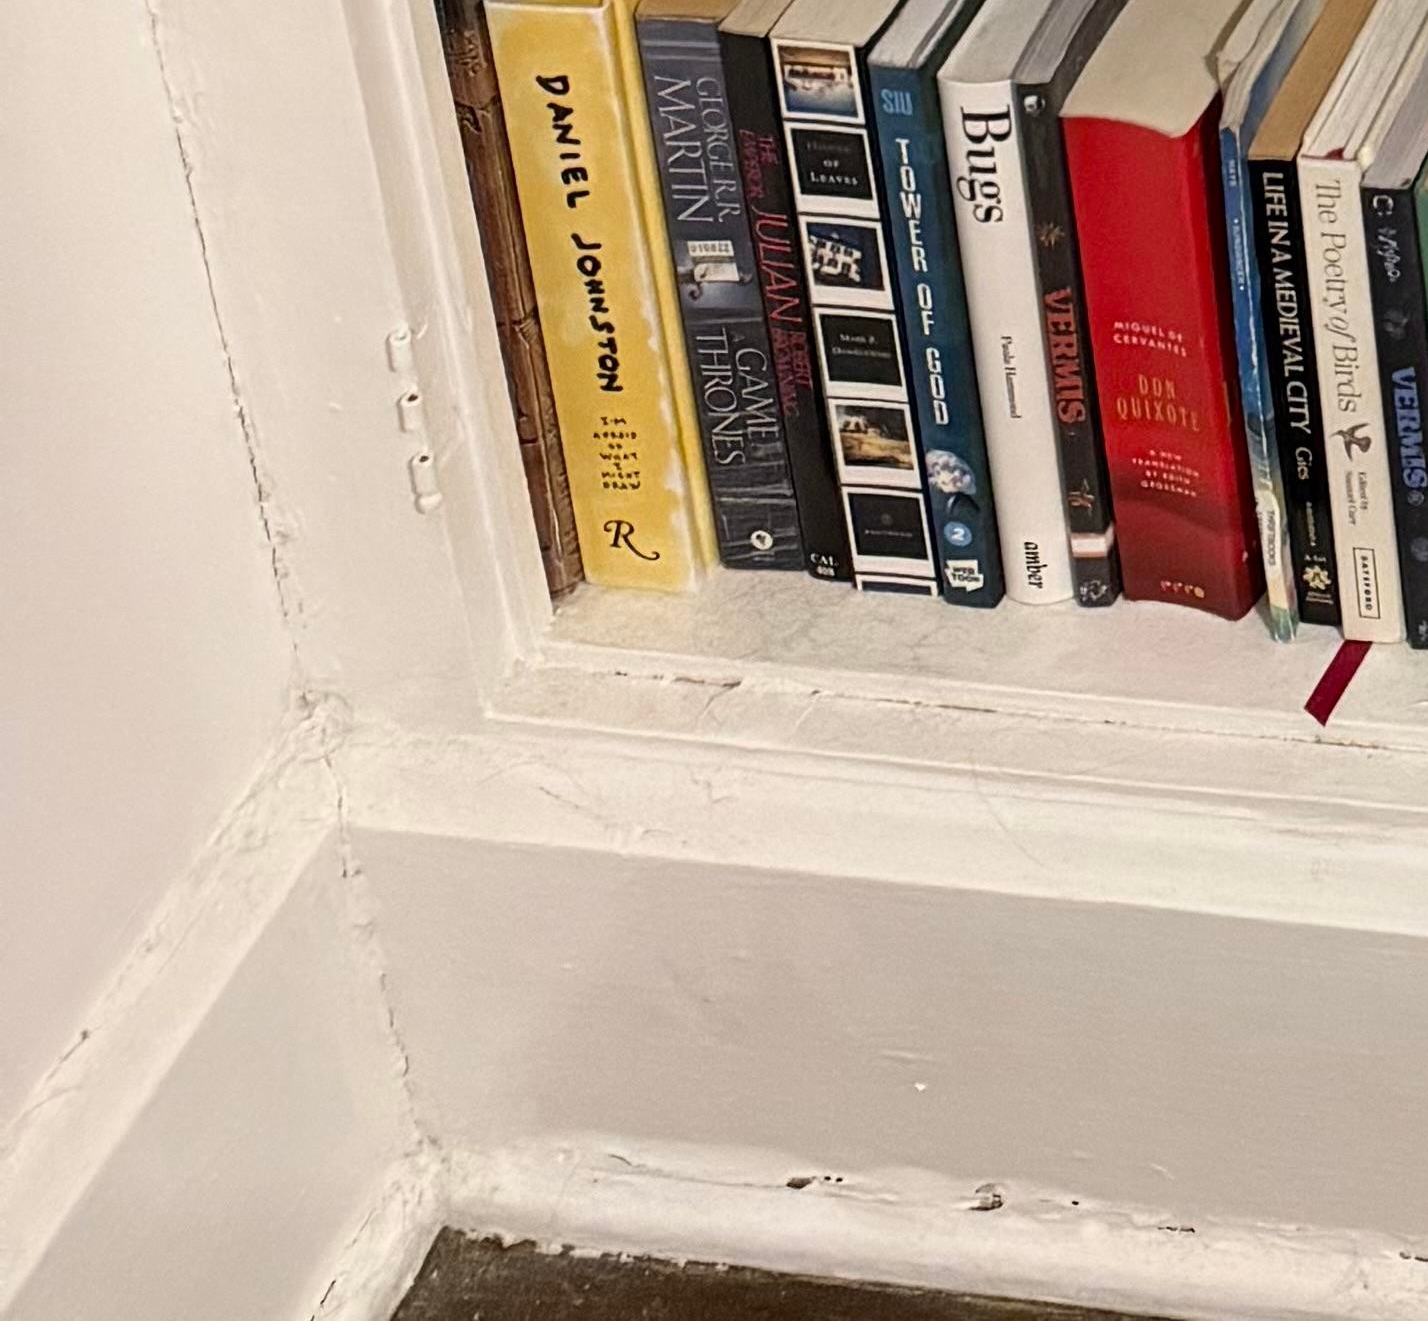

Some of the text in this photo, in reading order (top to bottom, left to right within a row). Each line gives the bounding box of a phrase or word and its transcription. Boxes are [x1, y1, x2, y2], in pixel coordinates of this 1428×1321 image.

[536, 74, 624, 393] DANIEL JOHNSTON
[895, 138, 927, 273] TOWER
[959, 106, 1012, 225] Bugs
[1044, 287, 1085, 424] VERMIS
